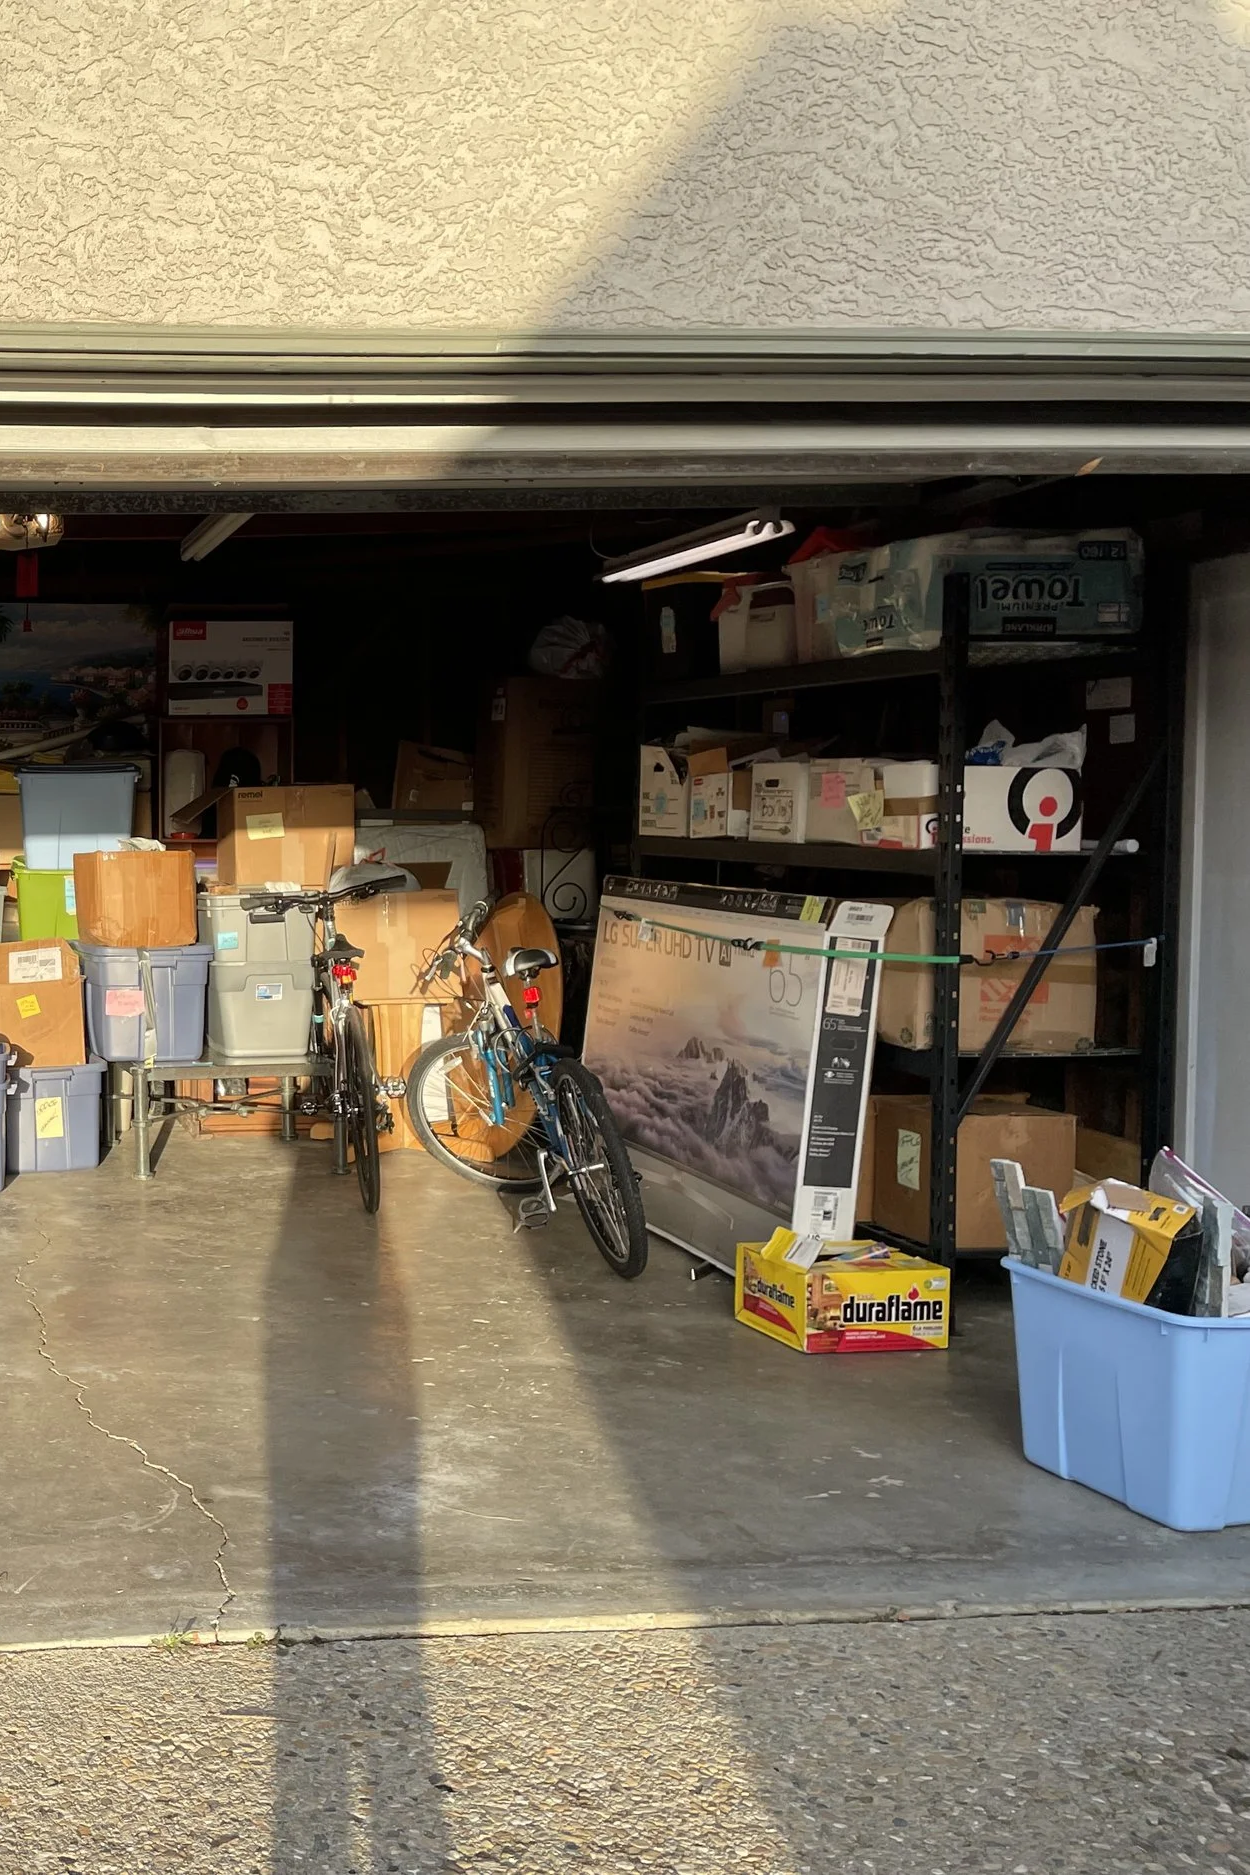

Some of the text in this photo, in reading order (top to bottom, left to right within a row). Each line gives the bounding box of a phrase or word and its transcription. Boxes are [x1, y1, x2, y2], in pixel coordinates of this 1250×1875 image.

[977, 576, 1085, 611] Towel
[603, 920, 619, 944] LG
[665, 928, 692, 960] UHD
[695, 935, 715, 963] TV
[1095, 1238, 1108, 1266] STONE
[757, 1279, 795, 1308] duraflame
[843, 1294, 942, 1323] duraflame
